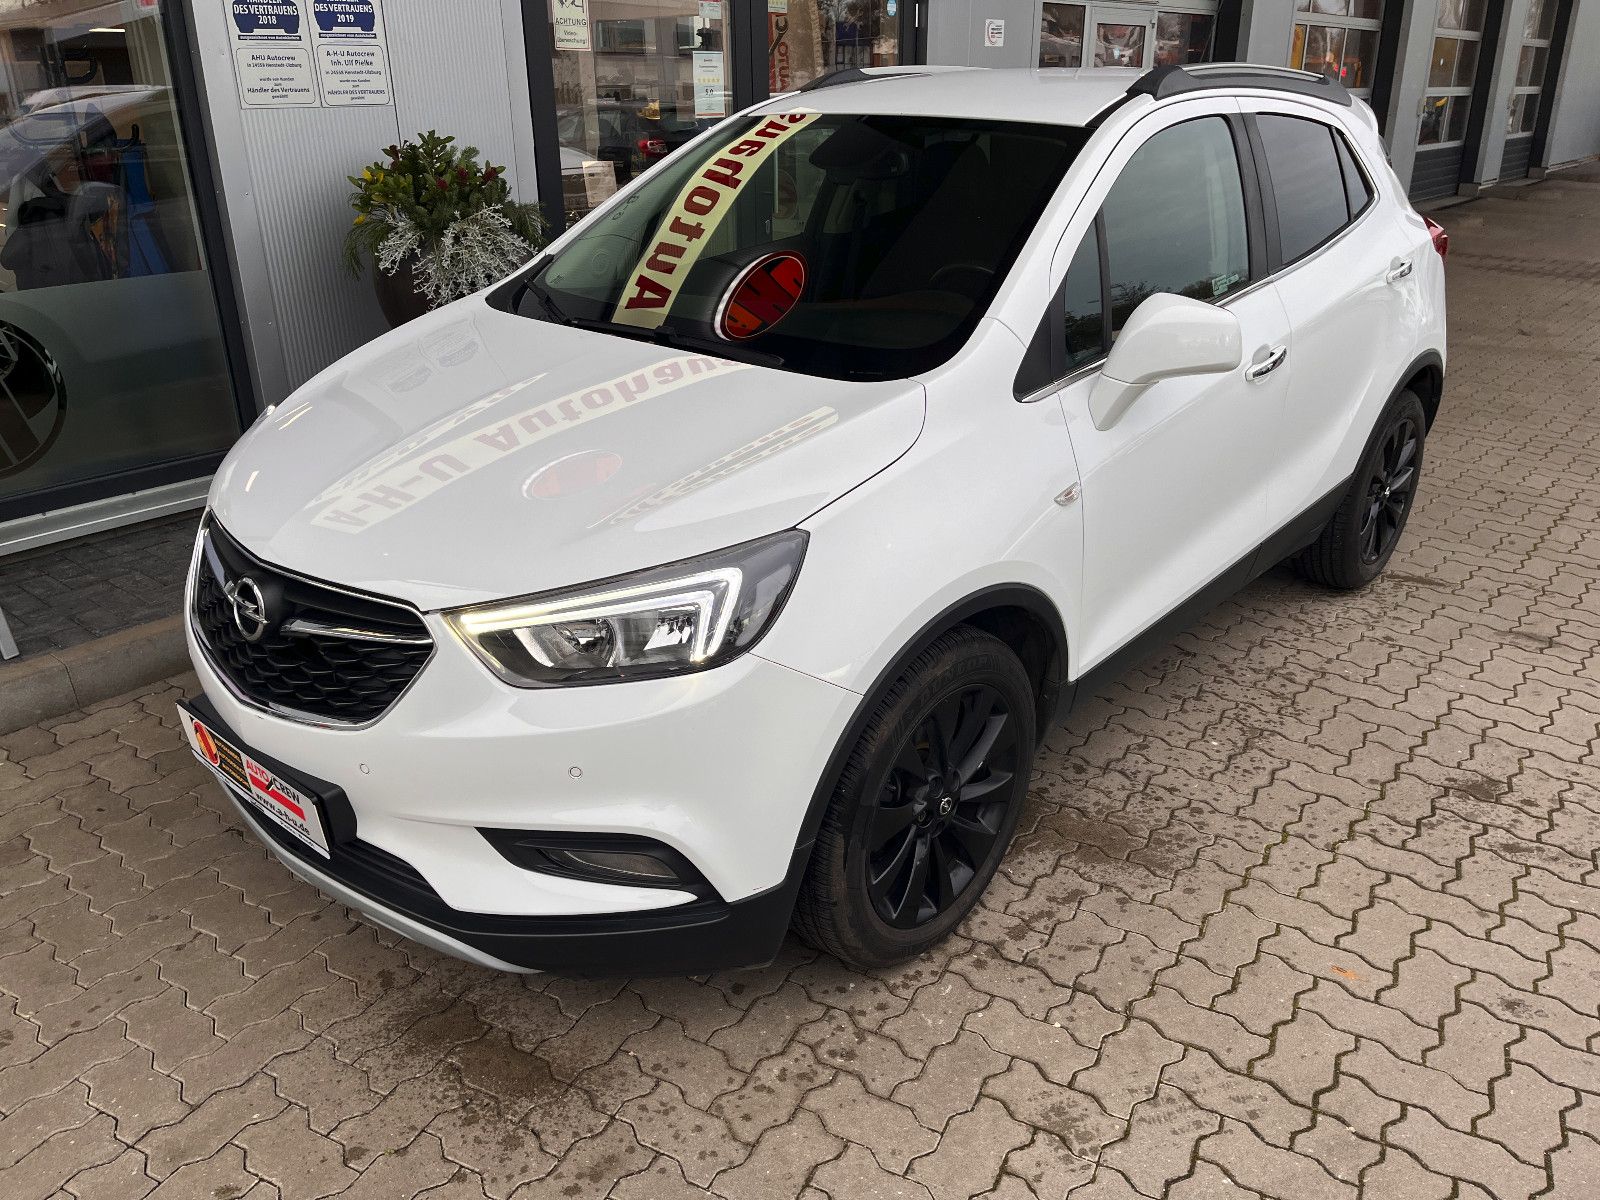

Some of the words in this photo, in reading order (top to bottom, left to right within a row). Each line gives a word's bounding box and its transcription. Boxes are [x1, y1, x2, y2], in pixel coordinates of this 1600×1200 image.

[233, 5, 249, 14] DES
[249, 5, 298, 15] VERTRAUENS
[314, 3, 329, 12] DES
[329, 4, 373, 13] VERTRAUENS
[257, 15, 277, 25] 2018
[336, 13, 355, 23] 2019
[555, 17, 587, 26] ACHTUNG
